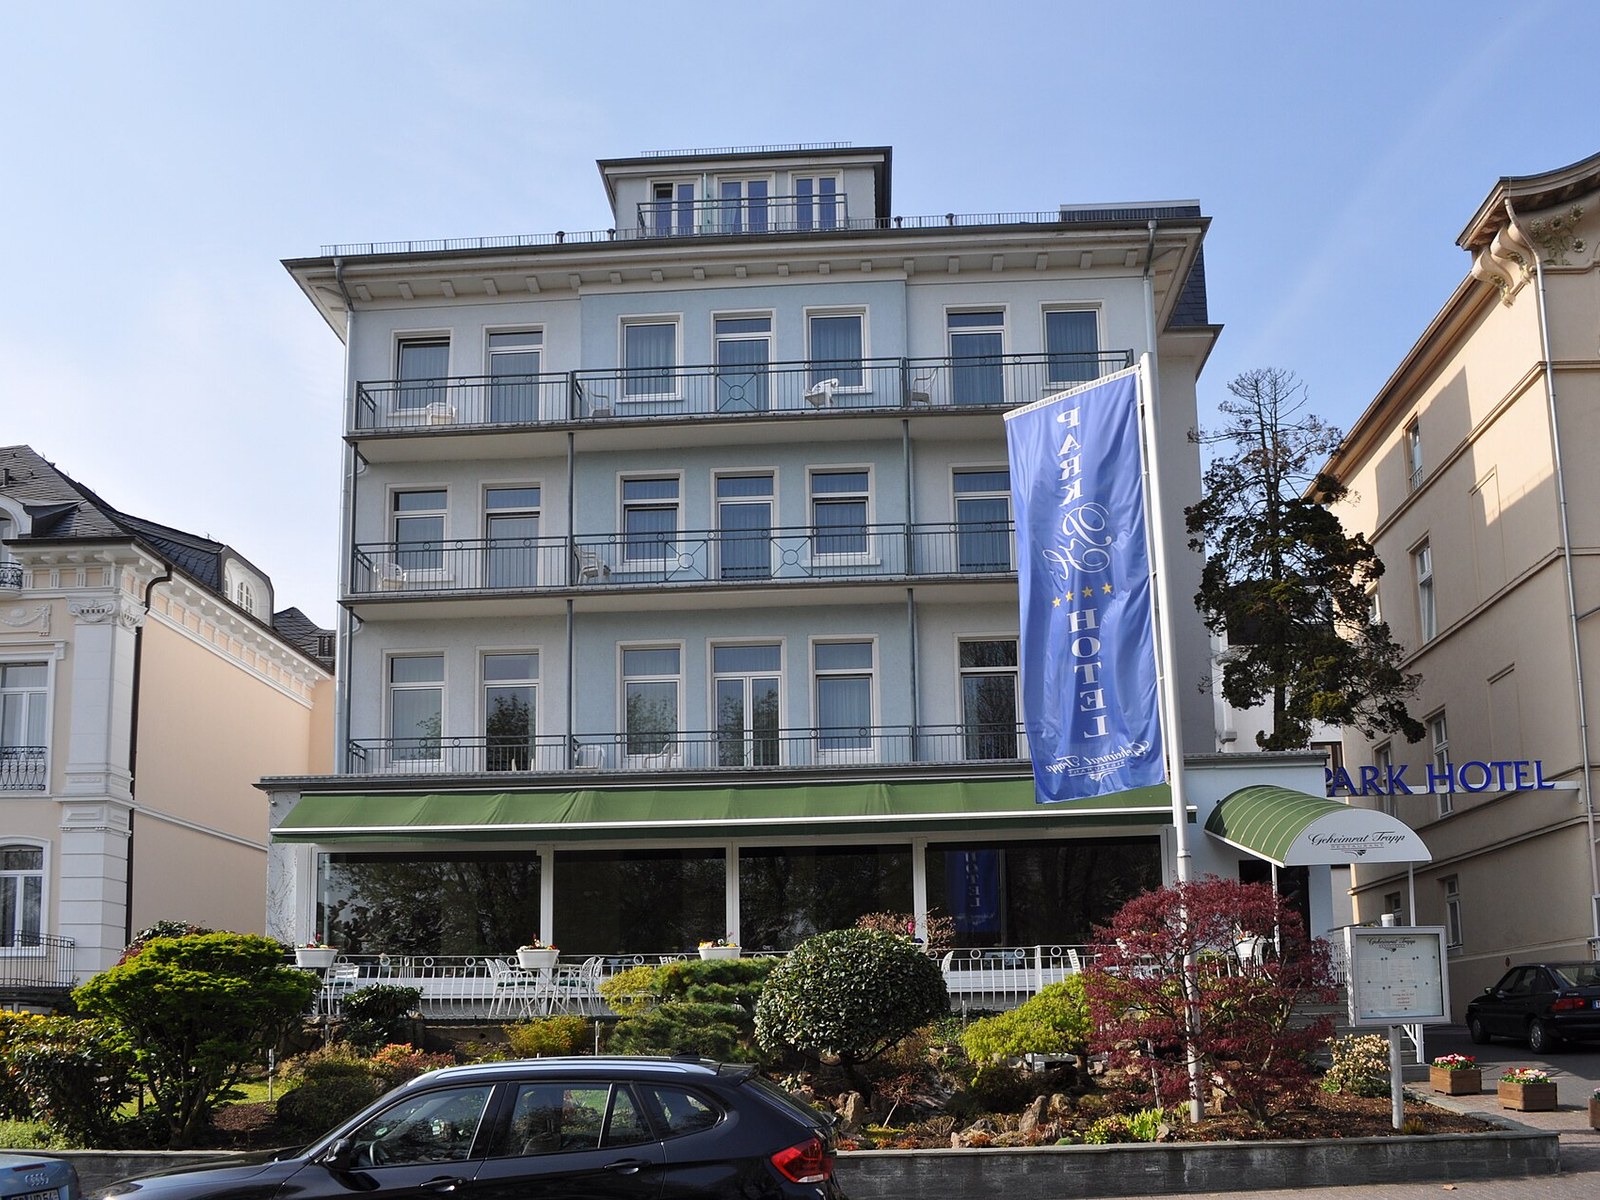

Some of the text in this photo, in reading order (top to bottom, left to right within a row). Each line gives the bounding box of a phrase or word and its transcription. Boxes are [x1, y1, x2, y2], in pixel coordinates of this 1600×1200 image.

[1425, 760, 1555, 794] HOTEL
[1308, 831, 1405, 849] Geheimrat Trapp
